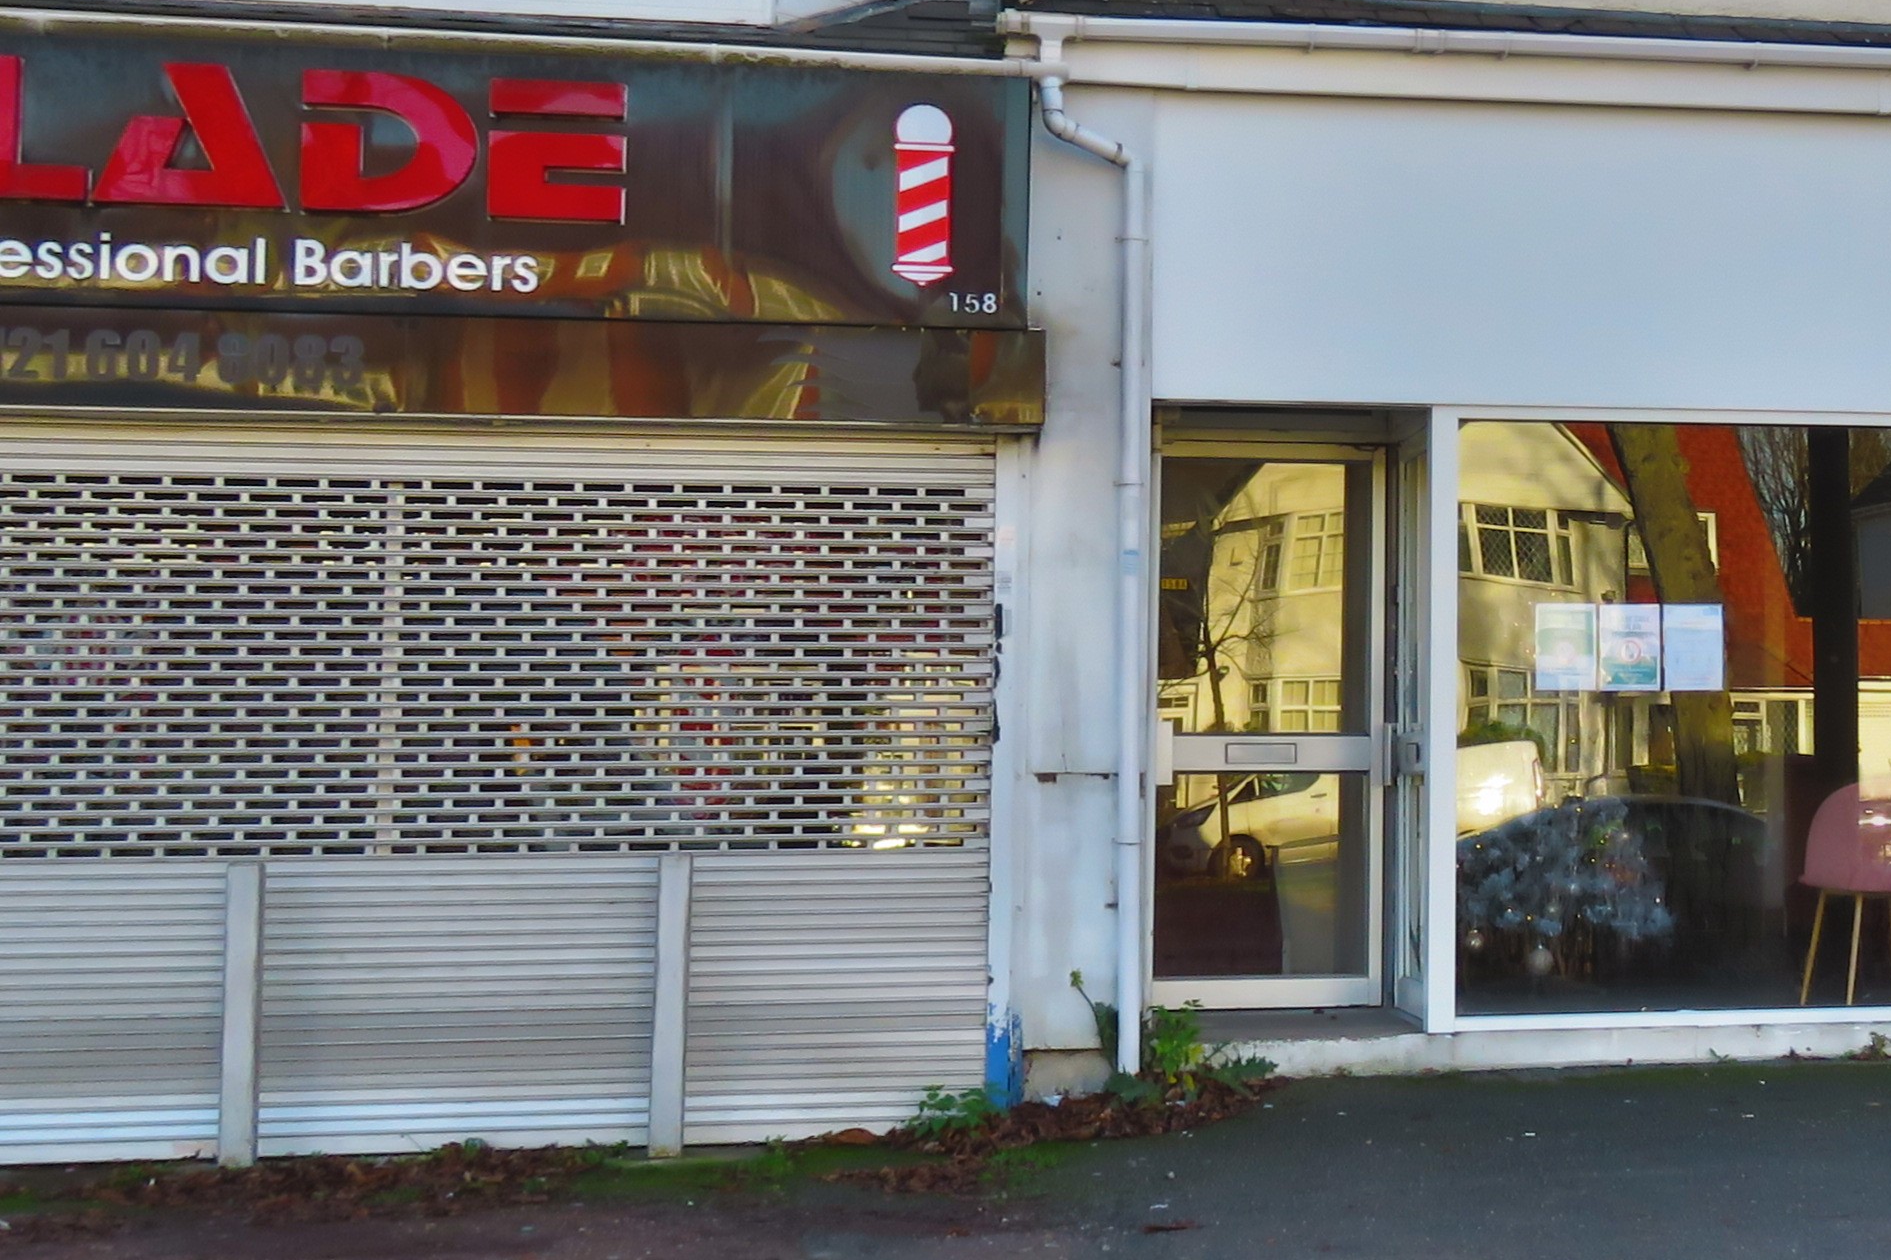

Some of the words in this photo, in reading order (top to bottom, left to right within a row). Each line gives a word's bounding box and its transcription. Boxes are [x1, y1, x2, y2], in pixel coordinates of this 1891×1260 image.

[0, 232, 266, 286] essional
[294, 239, 539, 293] Barbers
[949, 292, 998, 313] 158
[0, 327, 69, 381] 21
[86, 329, 200, 383] 604
